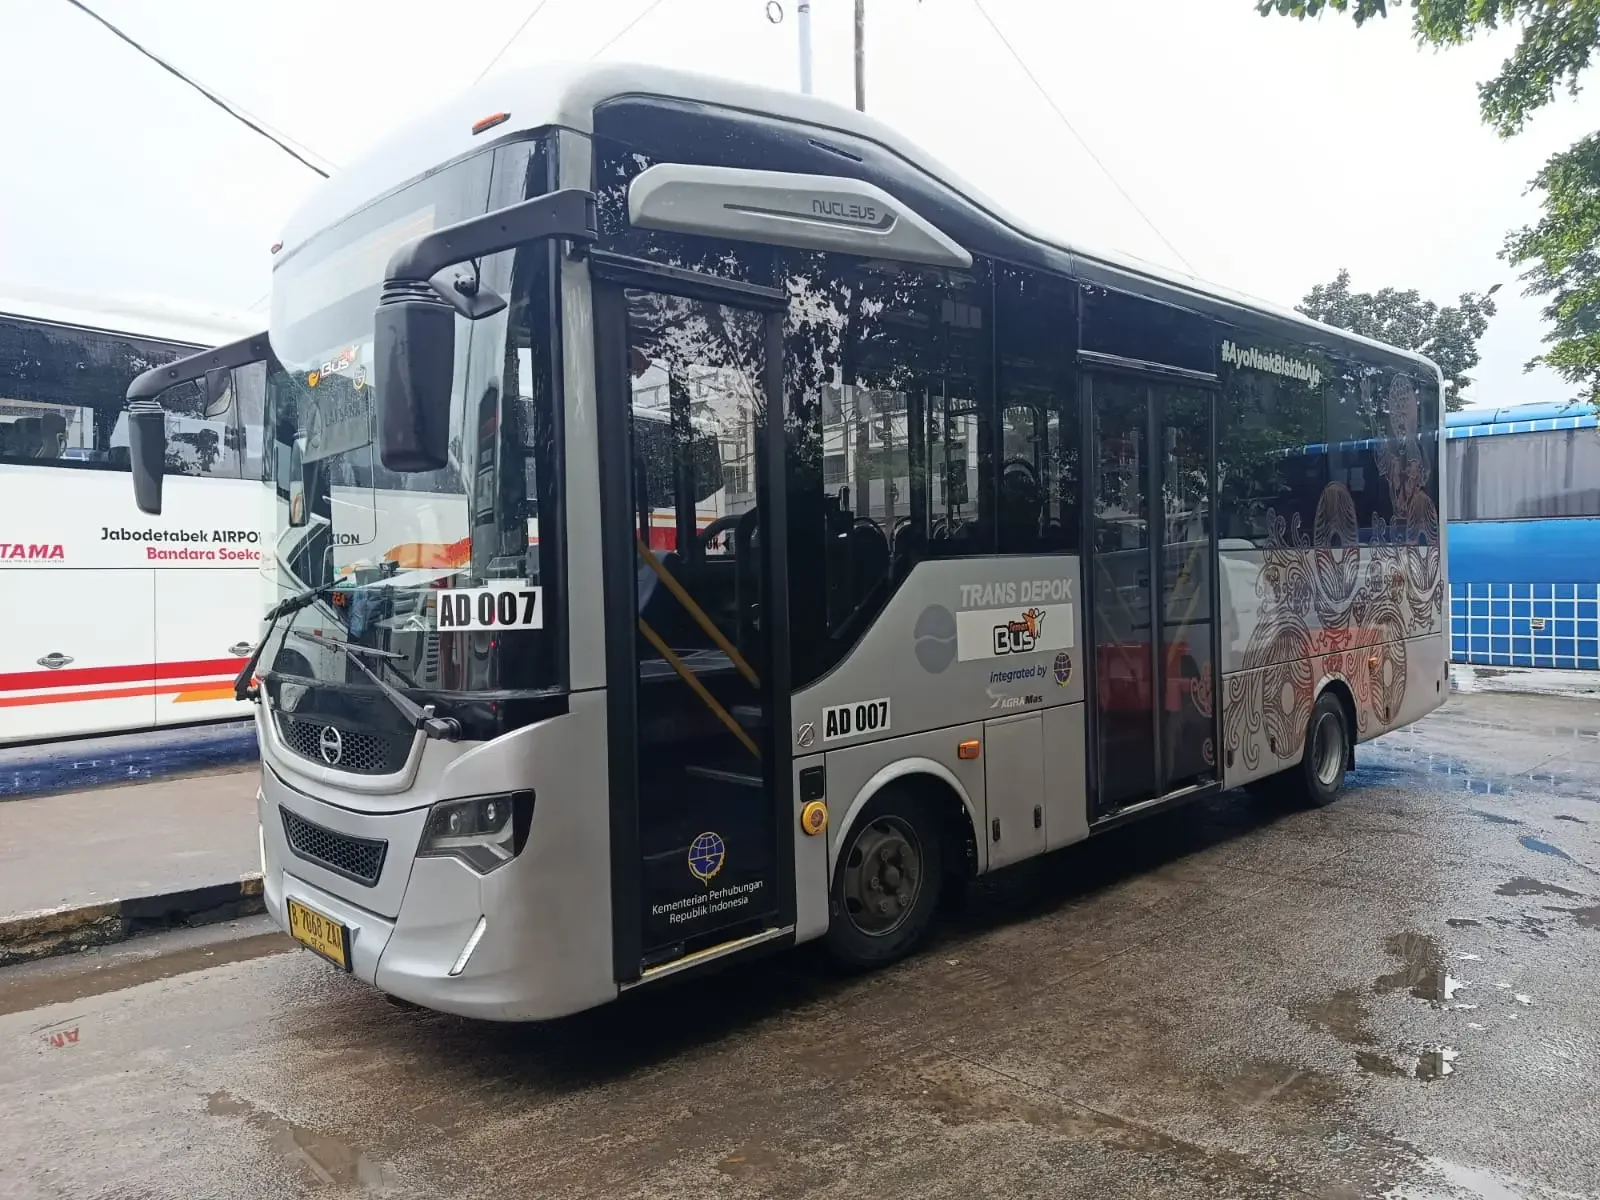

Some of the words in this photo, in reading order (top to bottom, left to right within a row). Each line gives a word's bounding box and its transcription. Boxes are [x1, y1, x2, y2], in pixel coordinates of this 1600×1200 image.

[812, 199, 876, 221] NUCLEUS
[101, 526, 208, 542] Jabodetabek
[212, 530, 261, 543] AIRPO
[0, 543, 65, 559] TAMA
[146, 546, 215, 561] Bandara
[960, 582, 1017, 608] TRANS
[1020, 578, 1073, 603] DEPOK
[440, 594, 471, 627] AD
[478, 591, 536, 626] 007
[1036, 664, 1048, 679] by
[826, 708, 851, 738] AD
[855, 701, 888, 732] 007
[652, 894, 708, 915] Kementerian
[709, 880, 763, 901] Perhubungan
[669, 905, 708, 924] Republik
[709, 896, 749, 914] Indonesia
[291, 903, 298, 926] B
[300, 909, 322, 938] 7068
